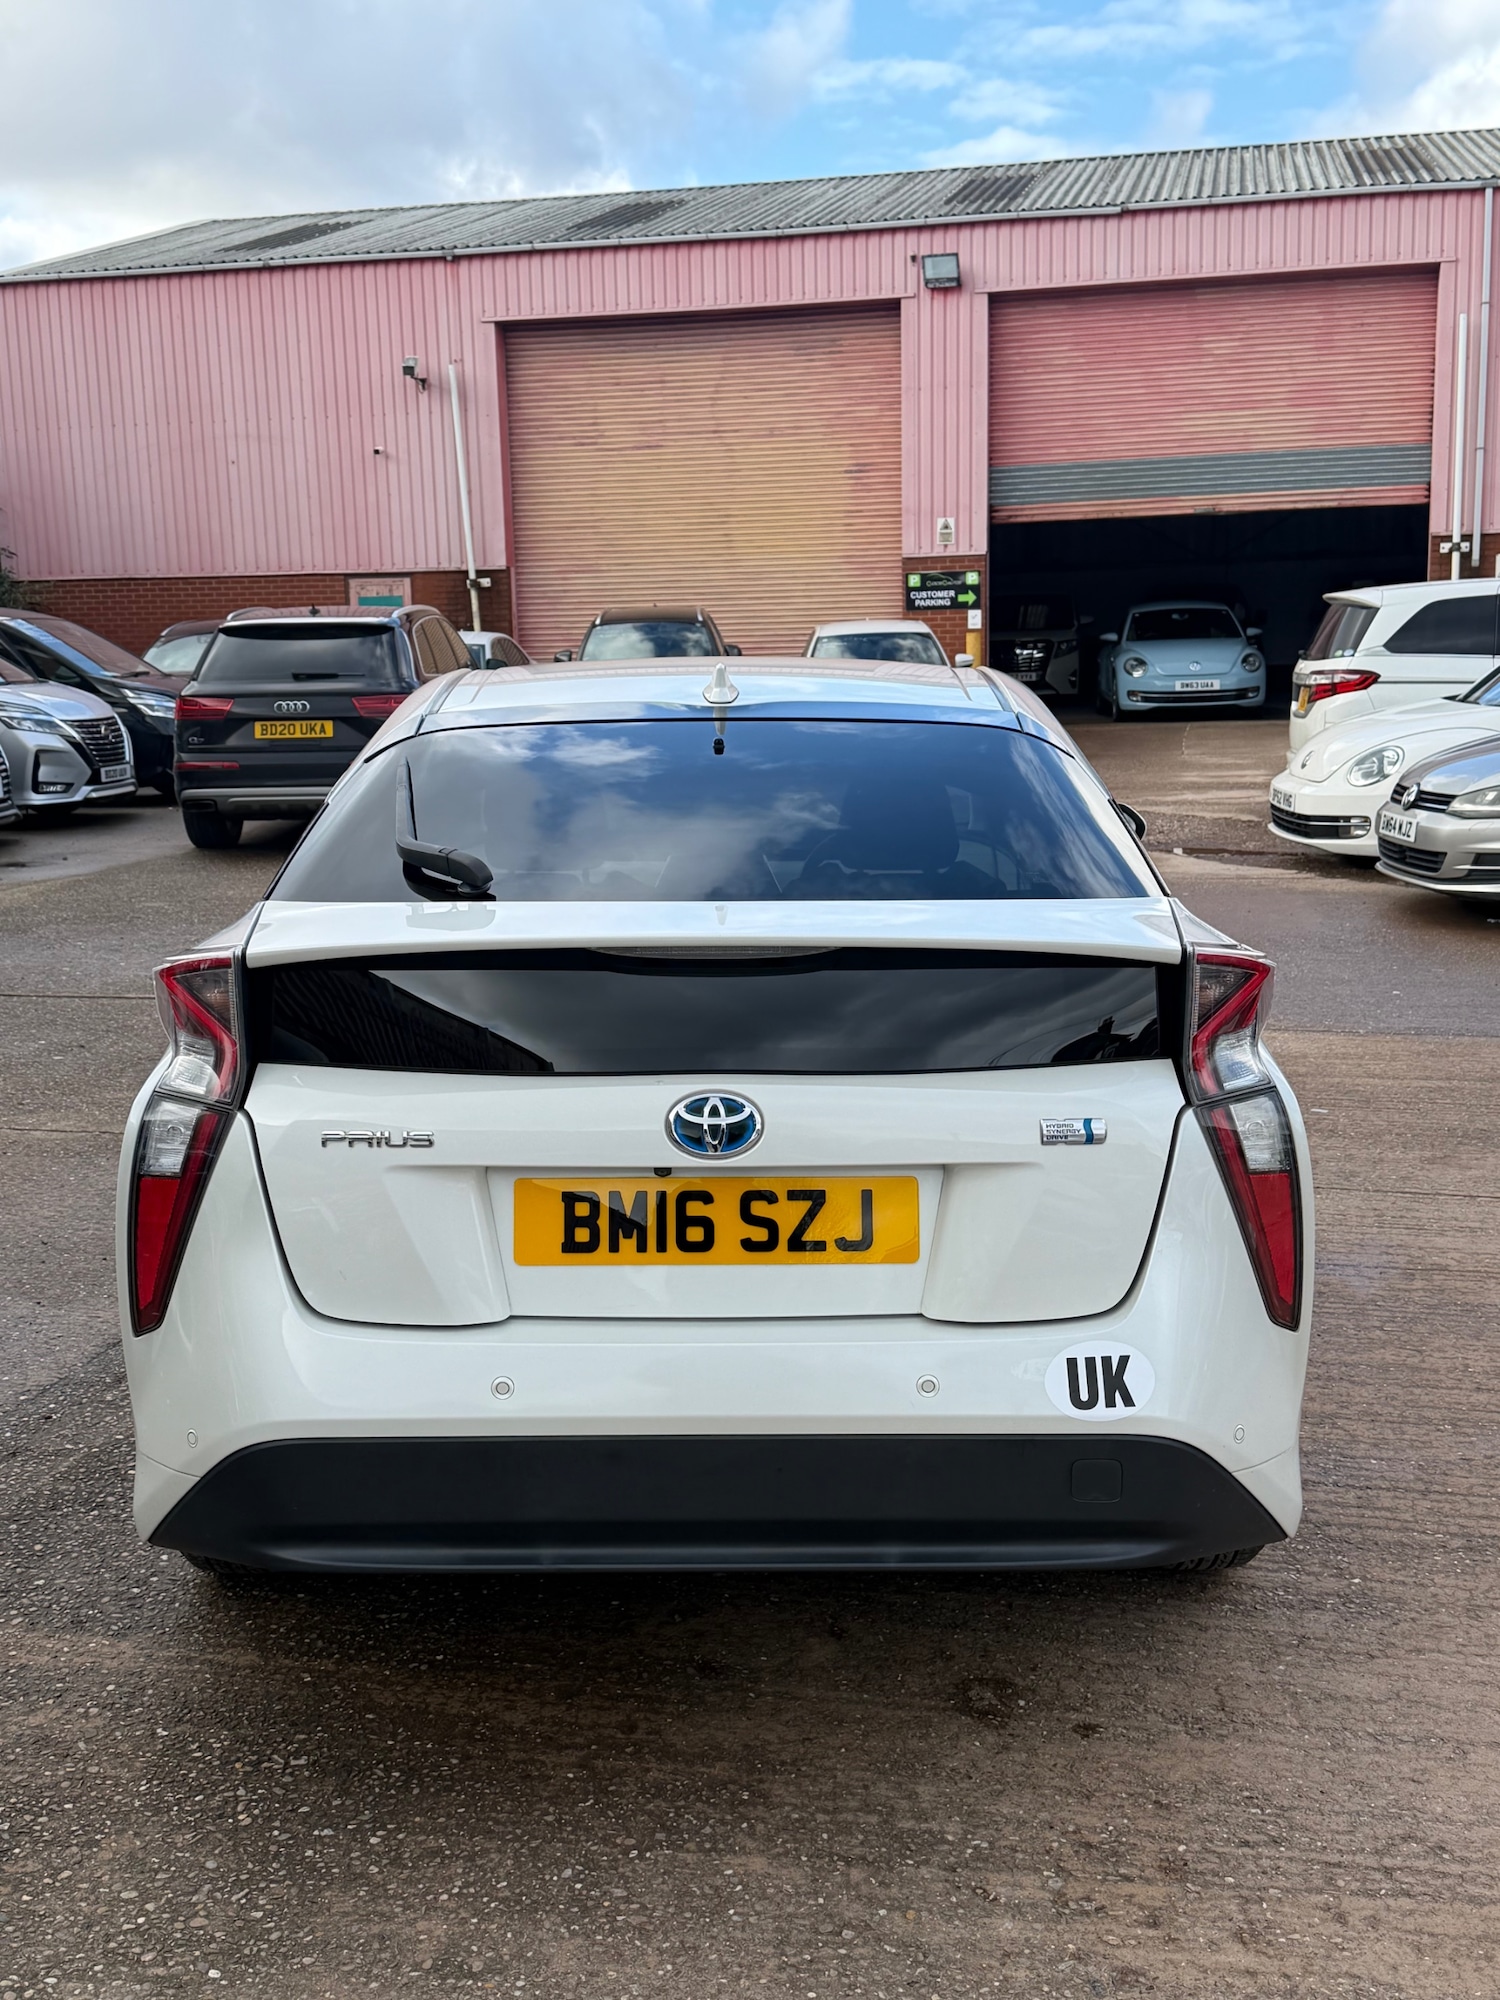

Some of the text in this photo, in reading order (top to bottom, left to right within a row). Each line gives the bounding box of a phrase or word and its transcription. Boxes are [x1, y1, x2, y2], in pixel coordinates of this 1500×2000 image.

[910, 590, 956, 599] CUSTOMER
[915, 598, 951, 607] PARKING
[260, 722, 327, 736] BD20 UKA
[321, 1130, 434, 1148] PRIUS
[561, 1189, 873, 1253] BM16 SZJ
[1066, 1355, 1136, 1410] UK
